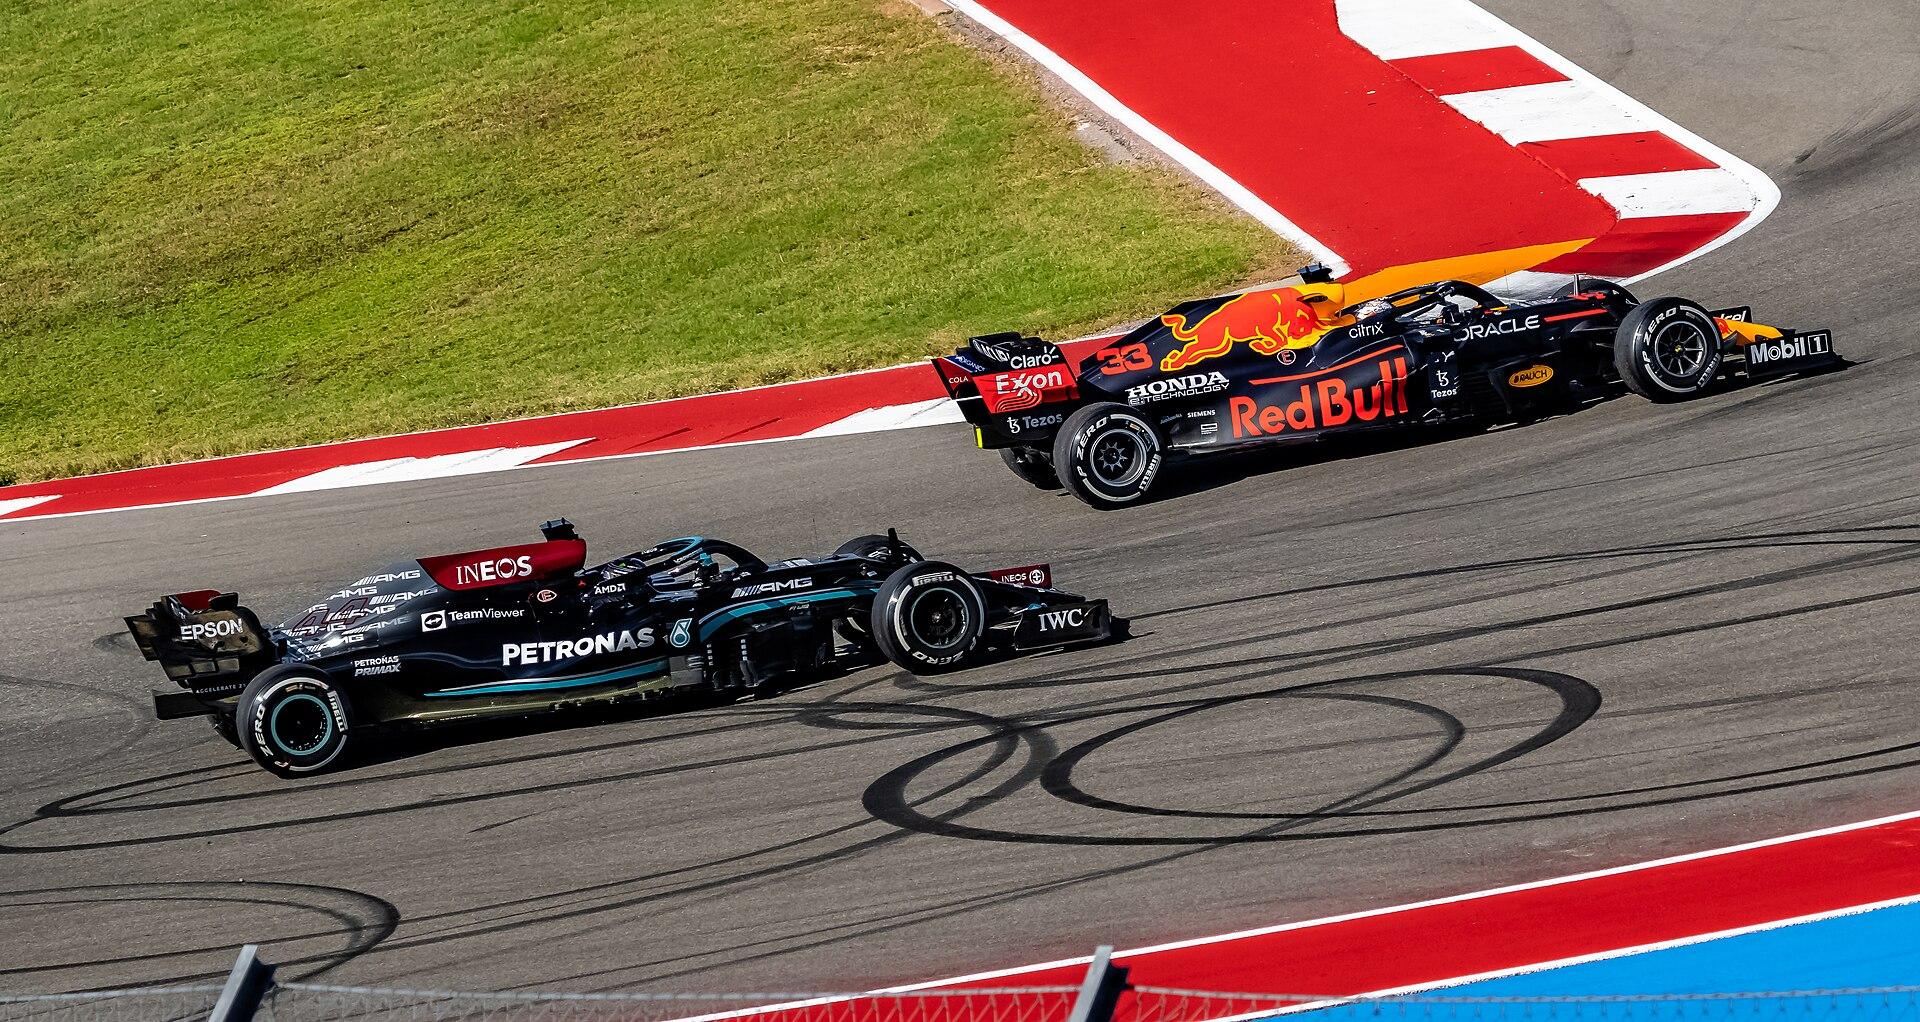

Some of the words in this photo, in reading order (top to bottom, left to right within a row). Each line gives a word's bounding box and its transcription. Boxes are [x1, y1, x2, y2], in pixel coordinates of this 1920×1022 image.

[1348, 321, 1385, 339] citrix
[1643, 307, 1677, 346] ZERO
[1096, 342, 1153, 376] 33
[1750, 336, 1806, 365] Mobil
[1010, 353, 1052, 370] Claro
[948, 375, 970, 385] COLA
[995, 370, 1063, 397] Exxon
[1519, 369, 1549, 382] RAUCH
[1124, 371, 1230, 399] HONDA
[1430, 387, 1459, 399] Tezos
[1022, 413, 1063, 430] Tezos
[1187, 409, 1216, 419] SIEMENS
[1076, 416, 1107, 461] ZERO
[456, 555, 533, 585] INEOS
[1001, 572, 1027, 584] INEOS
[594, 584, 618, 595] AMD
[447, 607, 525, 622] TeamViewer
[1038, 608, 1085, 633] IWC
[180, 618, 244, 641] EPSON
[502, 627, 656, 667] PETRONAS
[354, 655, 400, 668] PETRONAS
[354, 663, 402, 677] PRIMAX
[254, 703, 275, 757] ZERO
